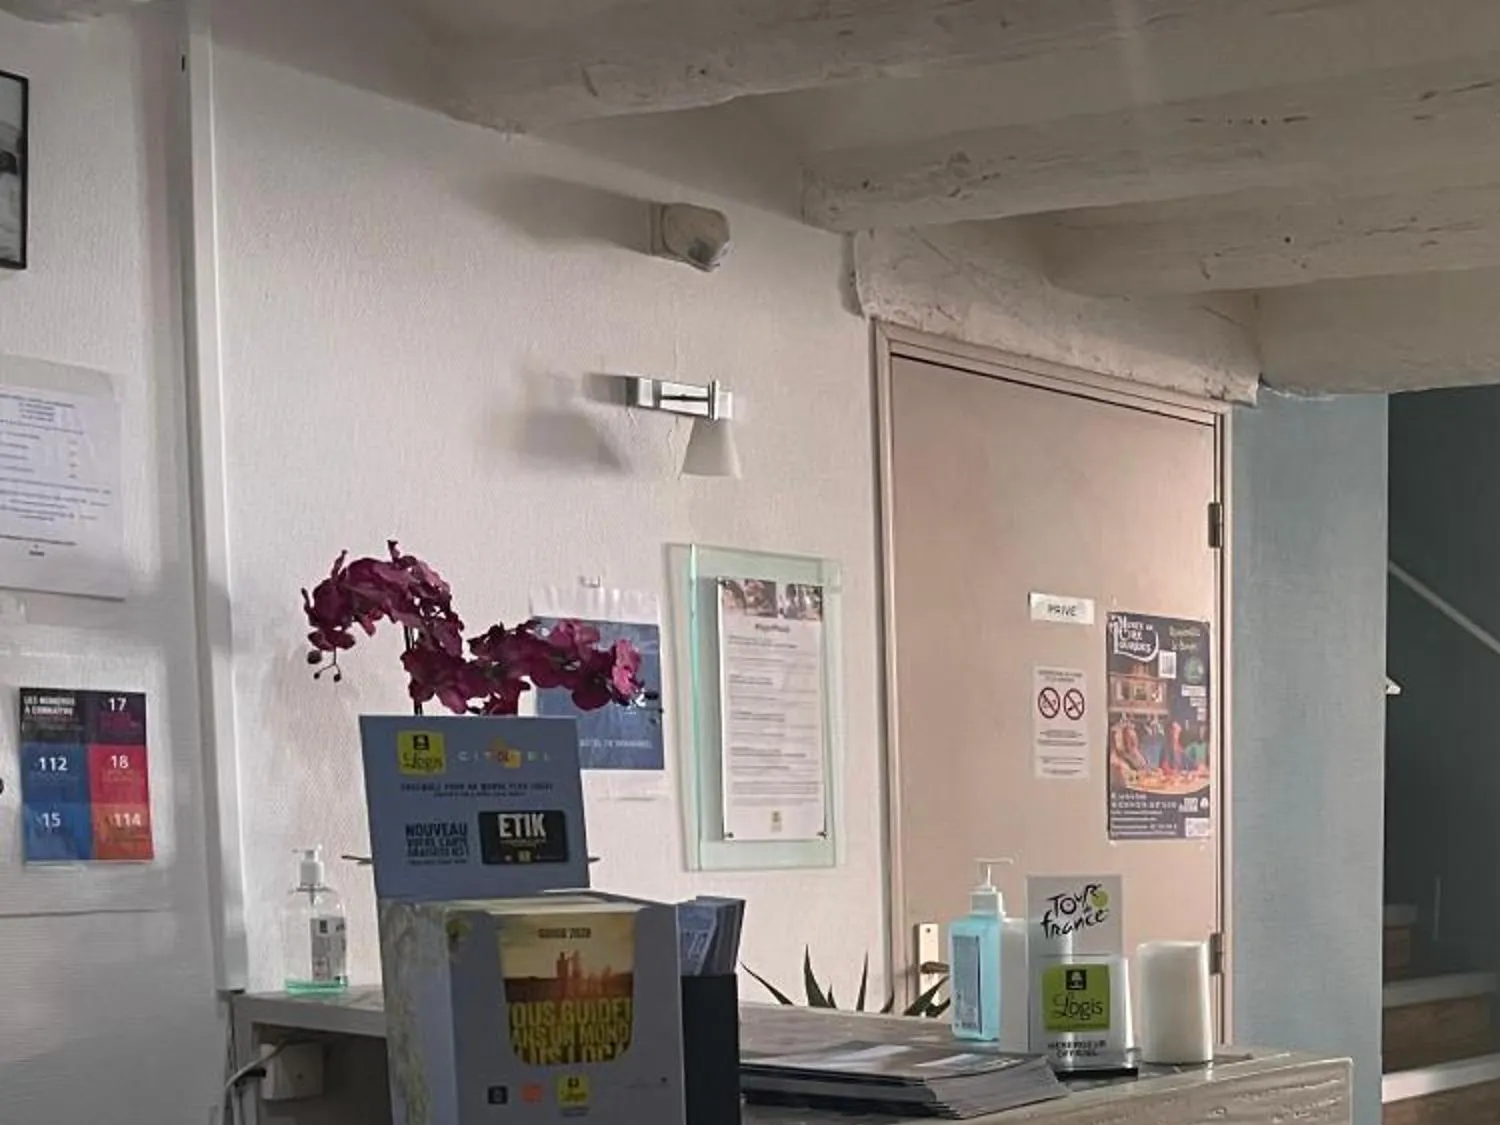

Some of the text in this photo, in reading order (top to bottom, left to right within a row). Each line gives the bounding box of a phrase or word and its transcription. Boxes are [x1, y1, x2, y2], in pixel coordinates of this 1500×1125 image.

[108, 698, 126, 711] 17
[39, 757, 67, 771] 112
[111, 755, 129, 769] 18
[42, 813, 61, 828] 15
[114, 813, 141, 827] 114
[498, 813, 546, 837] ETIK
[405, 823, 467, 836] NOUVEAU
